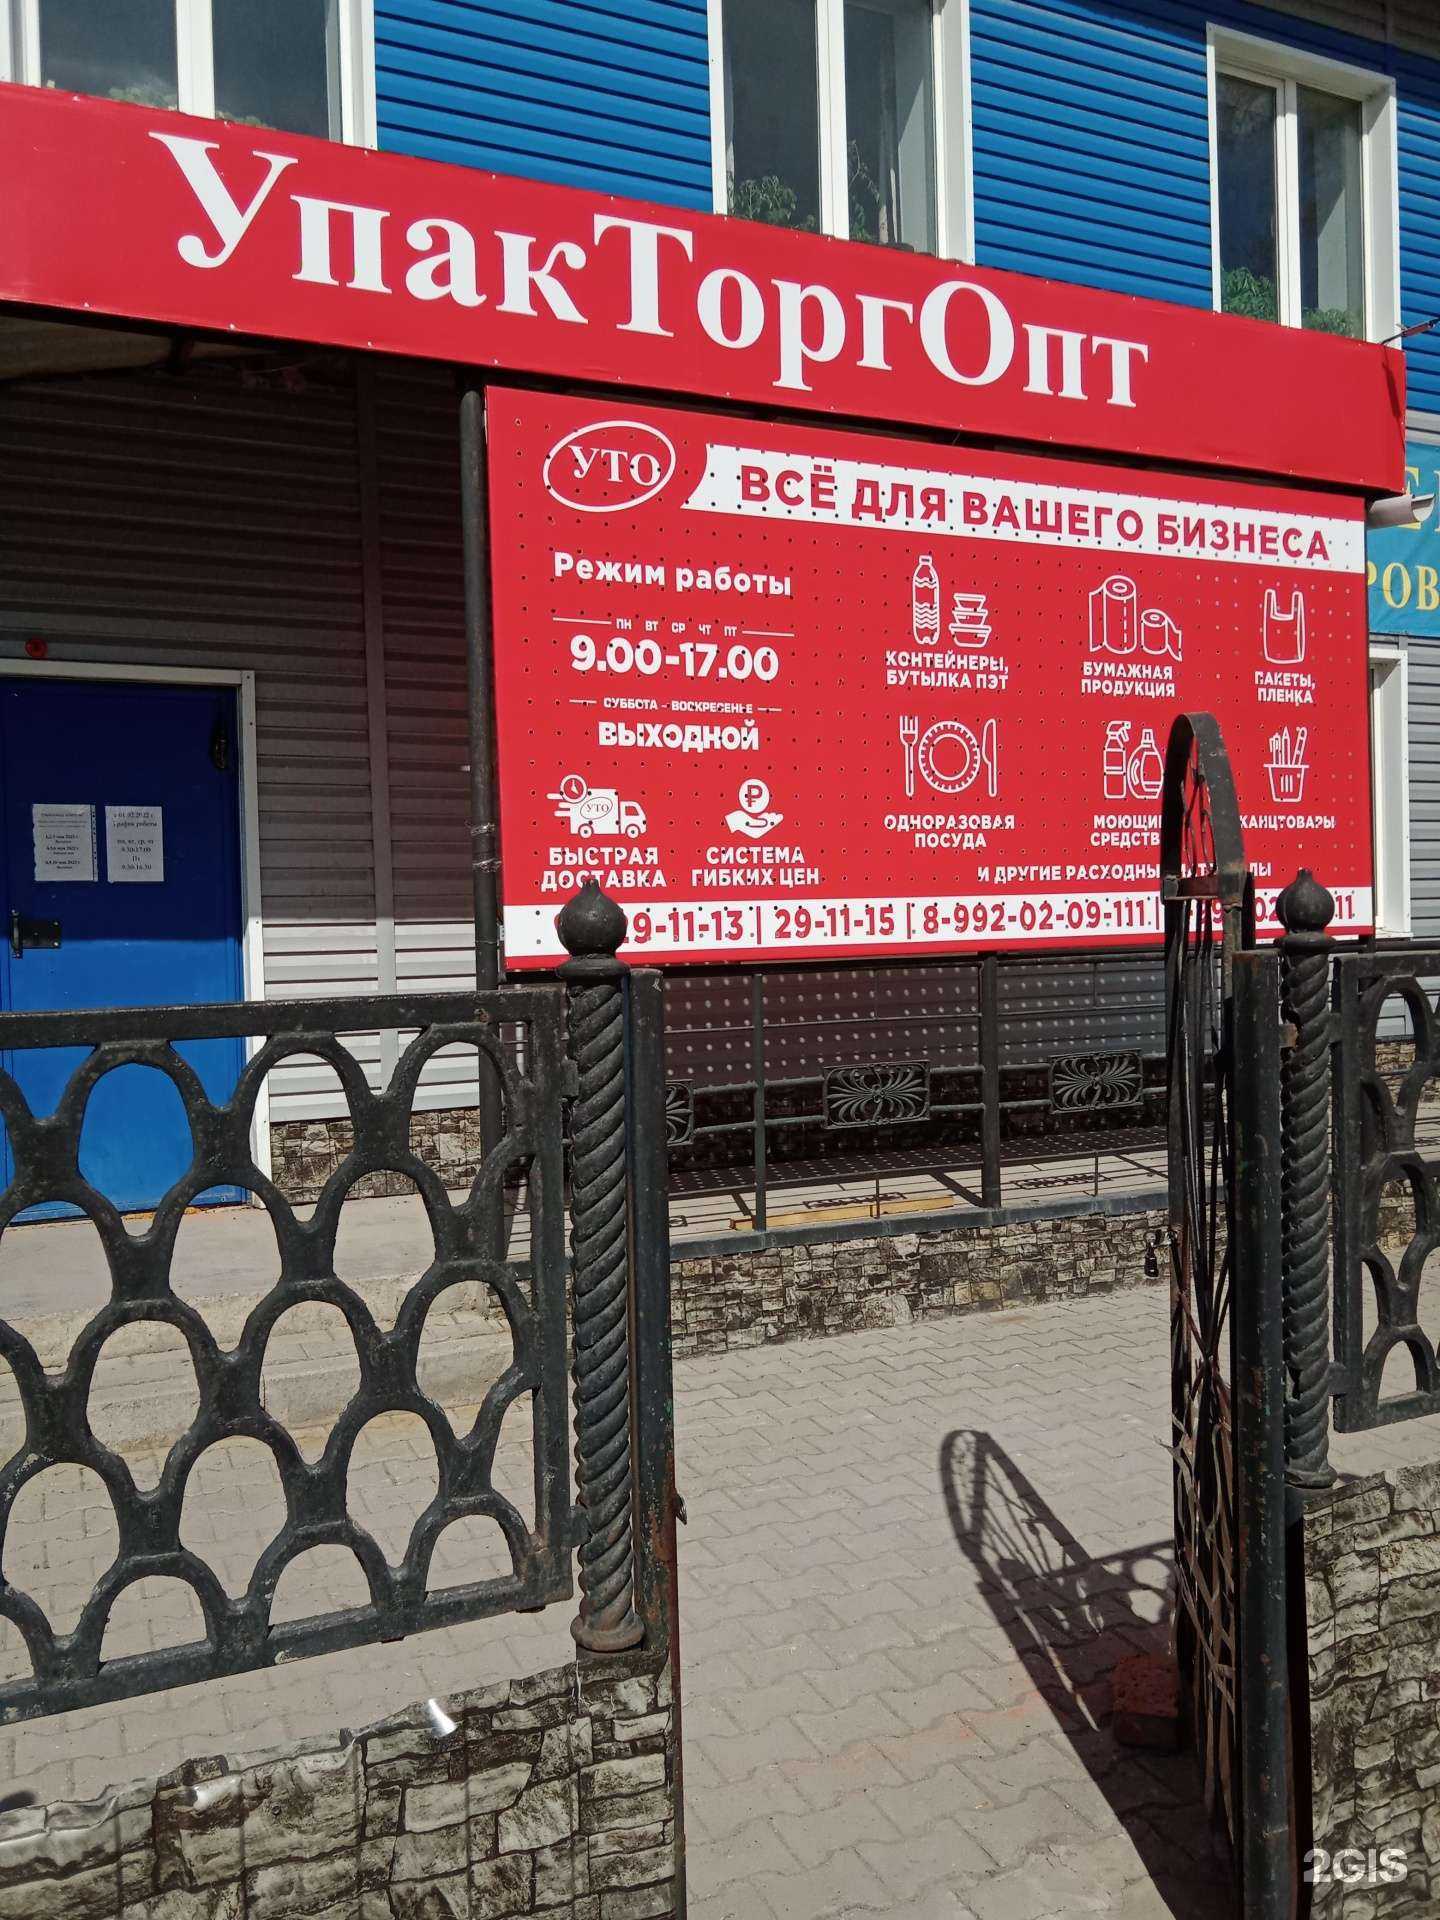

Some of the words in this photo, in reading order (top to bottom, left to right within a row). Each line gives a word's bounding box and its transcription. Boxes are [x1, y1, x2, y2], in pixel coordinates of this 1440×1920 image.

[149, 131, 1149, 408] УпакТоргОпт
[569, 445, 662, 486] УТО
[742, 465, 835, 509] ВСЁ
[851, 480, 945, 522] ДЛЯ
[962, 491, 1144, 541] ВАШЕГО
[1157, 513, 1330, 561] БИЗНЕСА
[555, 552, 665, 585] Режим
[676, 567, 790, 595] работы
[617, 619, 631, 629] ПН
[646, 621, 658, 631] ВТ
[672, 623, 685, 633] СР
[699, 624, 711, 634] ЧТ
[724, 626, 737, 636] ПТ
[570, 634, 779, 681] 9.00-17.00
[886, 650, 1008, 675] КОНТЕЙНЕРЫ,
[886, 669, 972, 689] БУТЫЛКА
[975, 672, 1009, 690] ПЭТ
[1082, 662, 1172, 681] БУМАЖНАЯ
[1255, 671, 1315, 690] ПАКЕТЫ,
[1080, 678, 1176, 699] ПРОДУКЦИЯ
[1258, 687, 1314, 706] ПЛЕНКА
[604, 698, 657, 709] СУББОТА
[672, 701, 752, 713] ВОСКРЕСЕНЬЕ
[599, 719, 758, 753] ВЫХОДНОЙ
[884, 815, 1014, 832] ОДНОРАЗОВАЯ
[1094, 815, 1161, 831] МОЮЩИ
[915, 833, 986, 849] ПОСУДА
[1091, 832, 1160, 848] СРЕДСТВ
[550, 847, 658, 865] БЫСТРАЯ
[707, 847, 804, 864] СИСТЕМА
[541, 870, 666, 892] ДОСТАВКА
[692, 869, 773, 886] ГИБКИХ
[780, 868, 819, 887] ЦЕН
[978, 867, 989, 881] И
[994, 866, 1061, 883] ДРУГИЕ
[1066, 864, 1160, 881] РАСХОДНЫ
[622, 909, 743, 944] 9-11-13
[774, 905, 895, 940] 29-11-15
[922, 899, 1145, 934] 8-992-02-09-111
